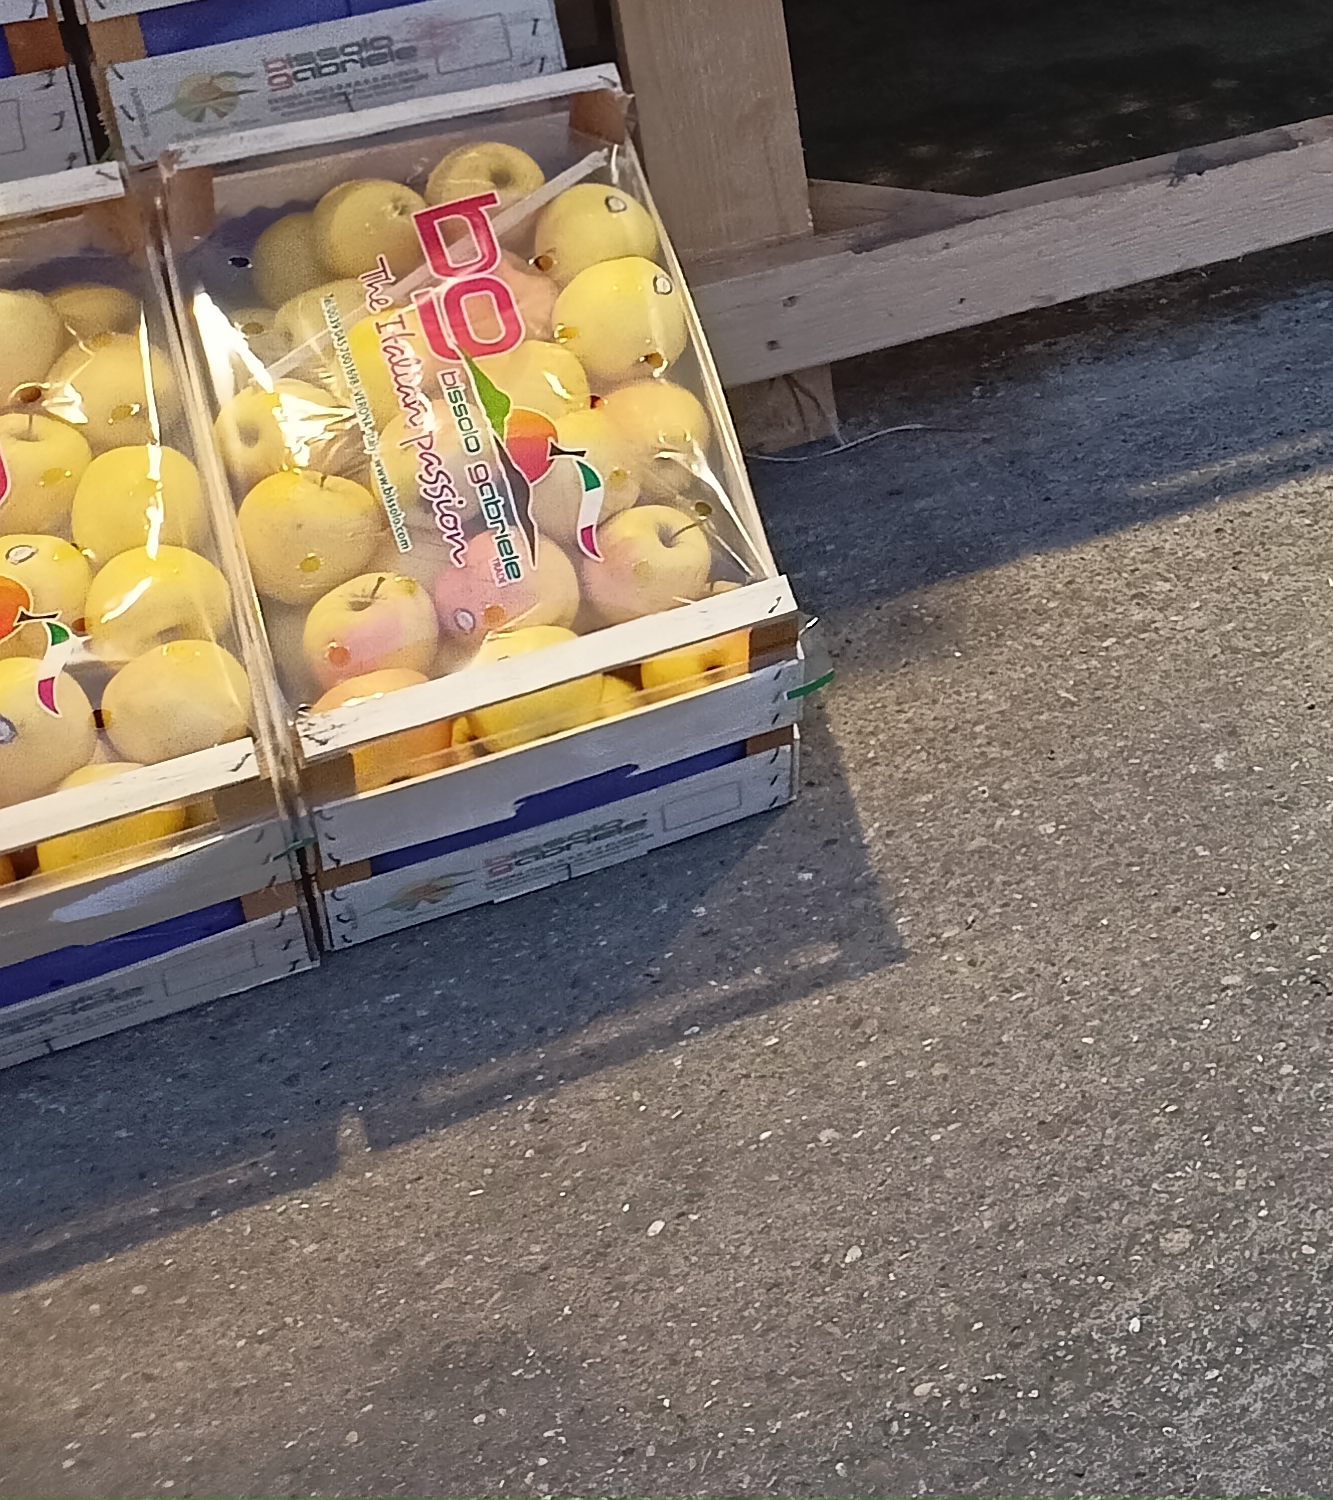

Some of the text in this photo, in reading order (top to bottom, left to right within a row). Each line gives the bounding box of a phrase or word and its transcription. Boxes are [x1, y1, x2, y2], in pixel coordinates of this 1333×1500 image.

[361, 256, 395, 312] The
[373, 457, 411, 550] www.bissolo.com
[441, 370, 522, 581] bissolo gabriele
